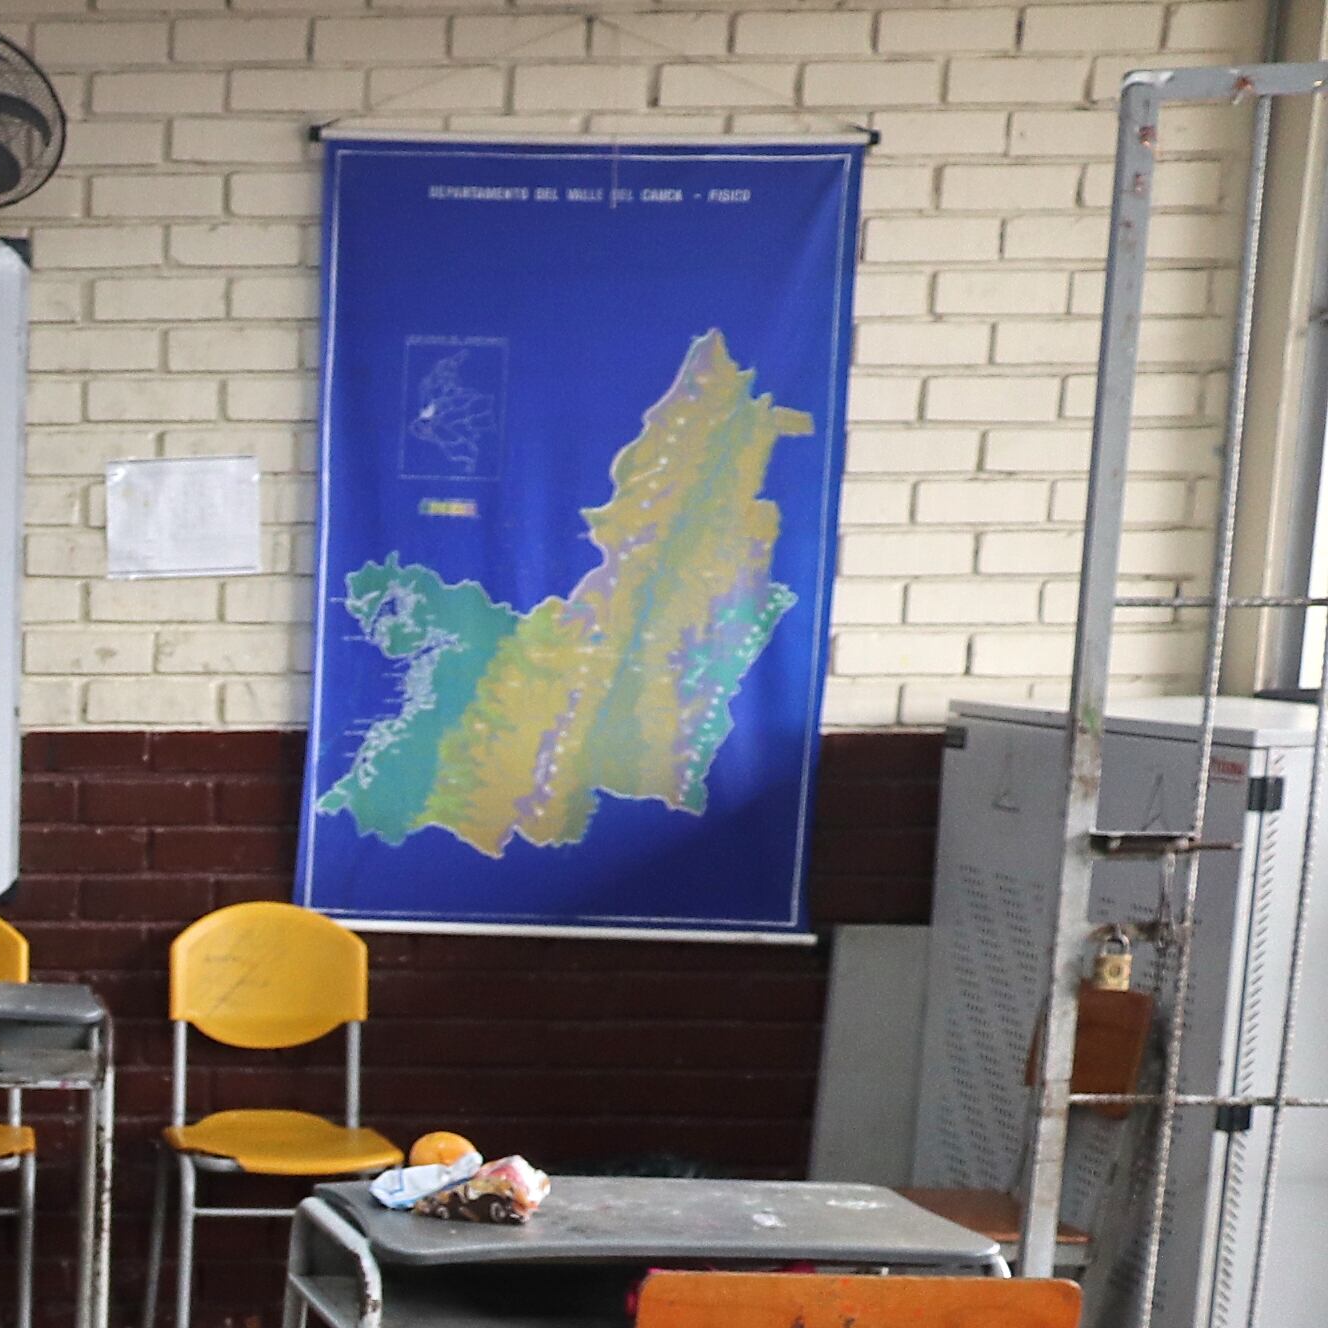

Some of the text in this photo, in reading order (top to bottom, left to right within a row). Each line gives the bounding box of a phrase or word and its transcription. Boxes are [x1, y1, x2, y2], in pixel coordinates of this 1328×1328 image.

[428, 185, 530, 200] DEPARTAMENTO
[534, 186, 559, 201] DEL
[566, 187, 604, 201] VALLE
[611, 188, 633, 201] DEL
[640, 188, 684, 201] CAUCA
